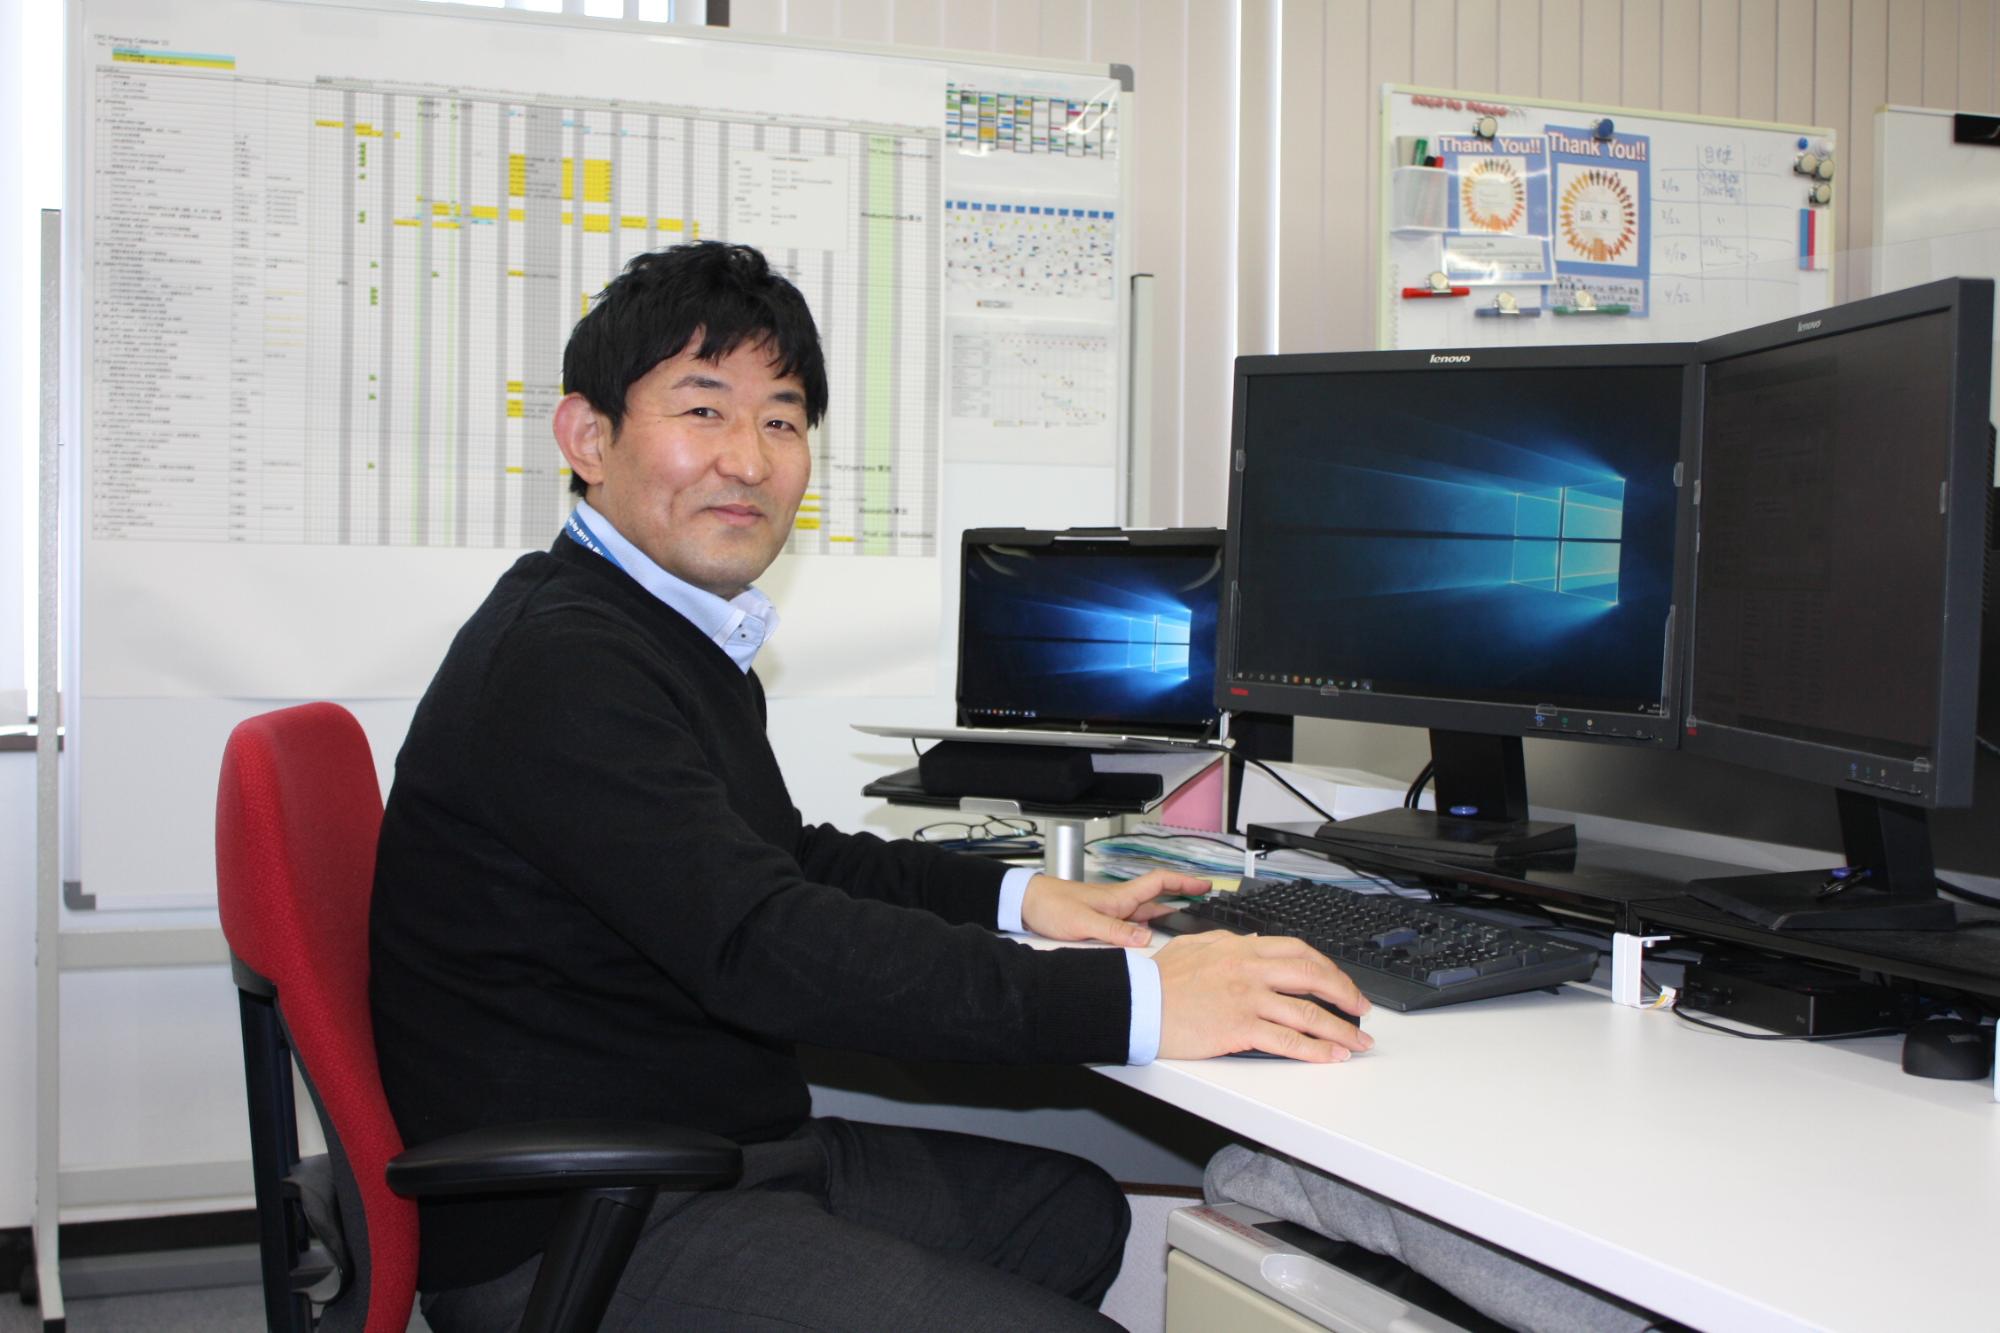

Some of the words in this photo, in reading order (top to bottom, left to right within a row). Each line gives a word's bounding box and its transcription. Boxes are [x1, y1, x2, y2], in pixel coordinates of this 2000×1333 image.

[1440, 137, 1494, 153] Thank
[1499, 138, 1541, 153] You!!
[1548, 131, 1600, 155] Thank
[1607, 138, 1647, 160] You!!
[1797, 319, 1822, 332] lenovo
[1429, 354, 1471, 363] lenovo
